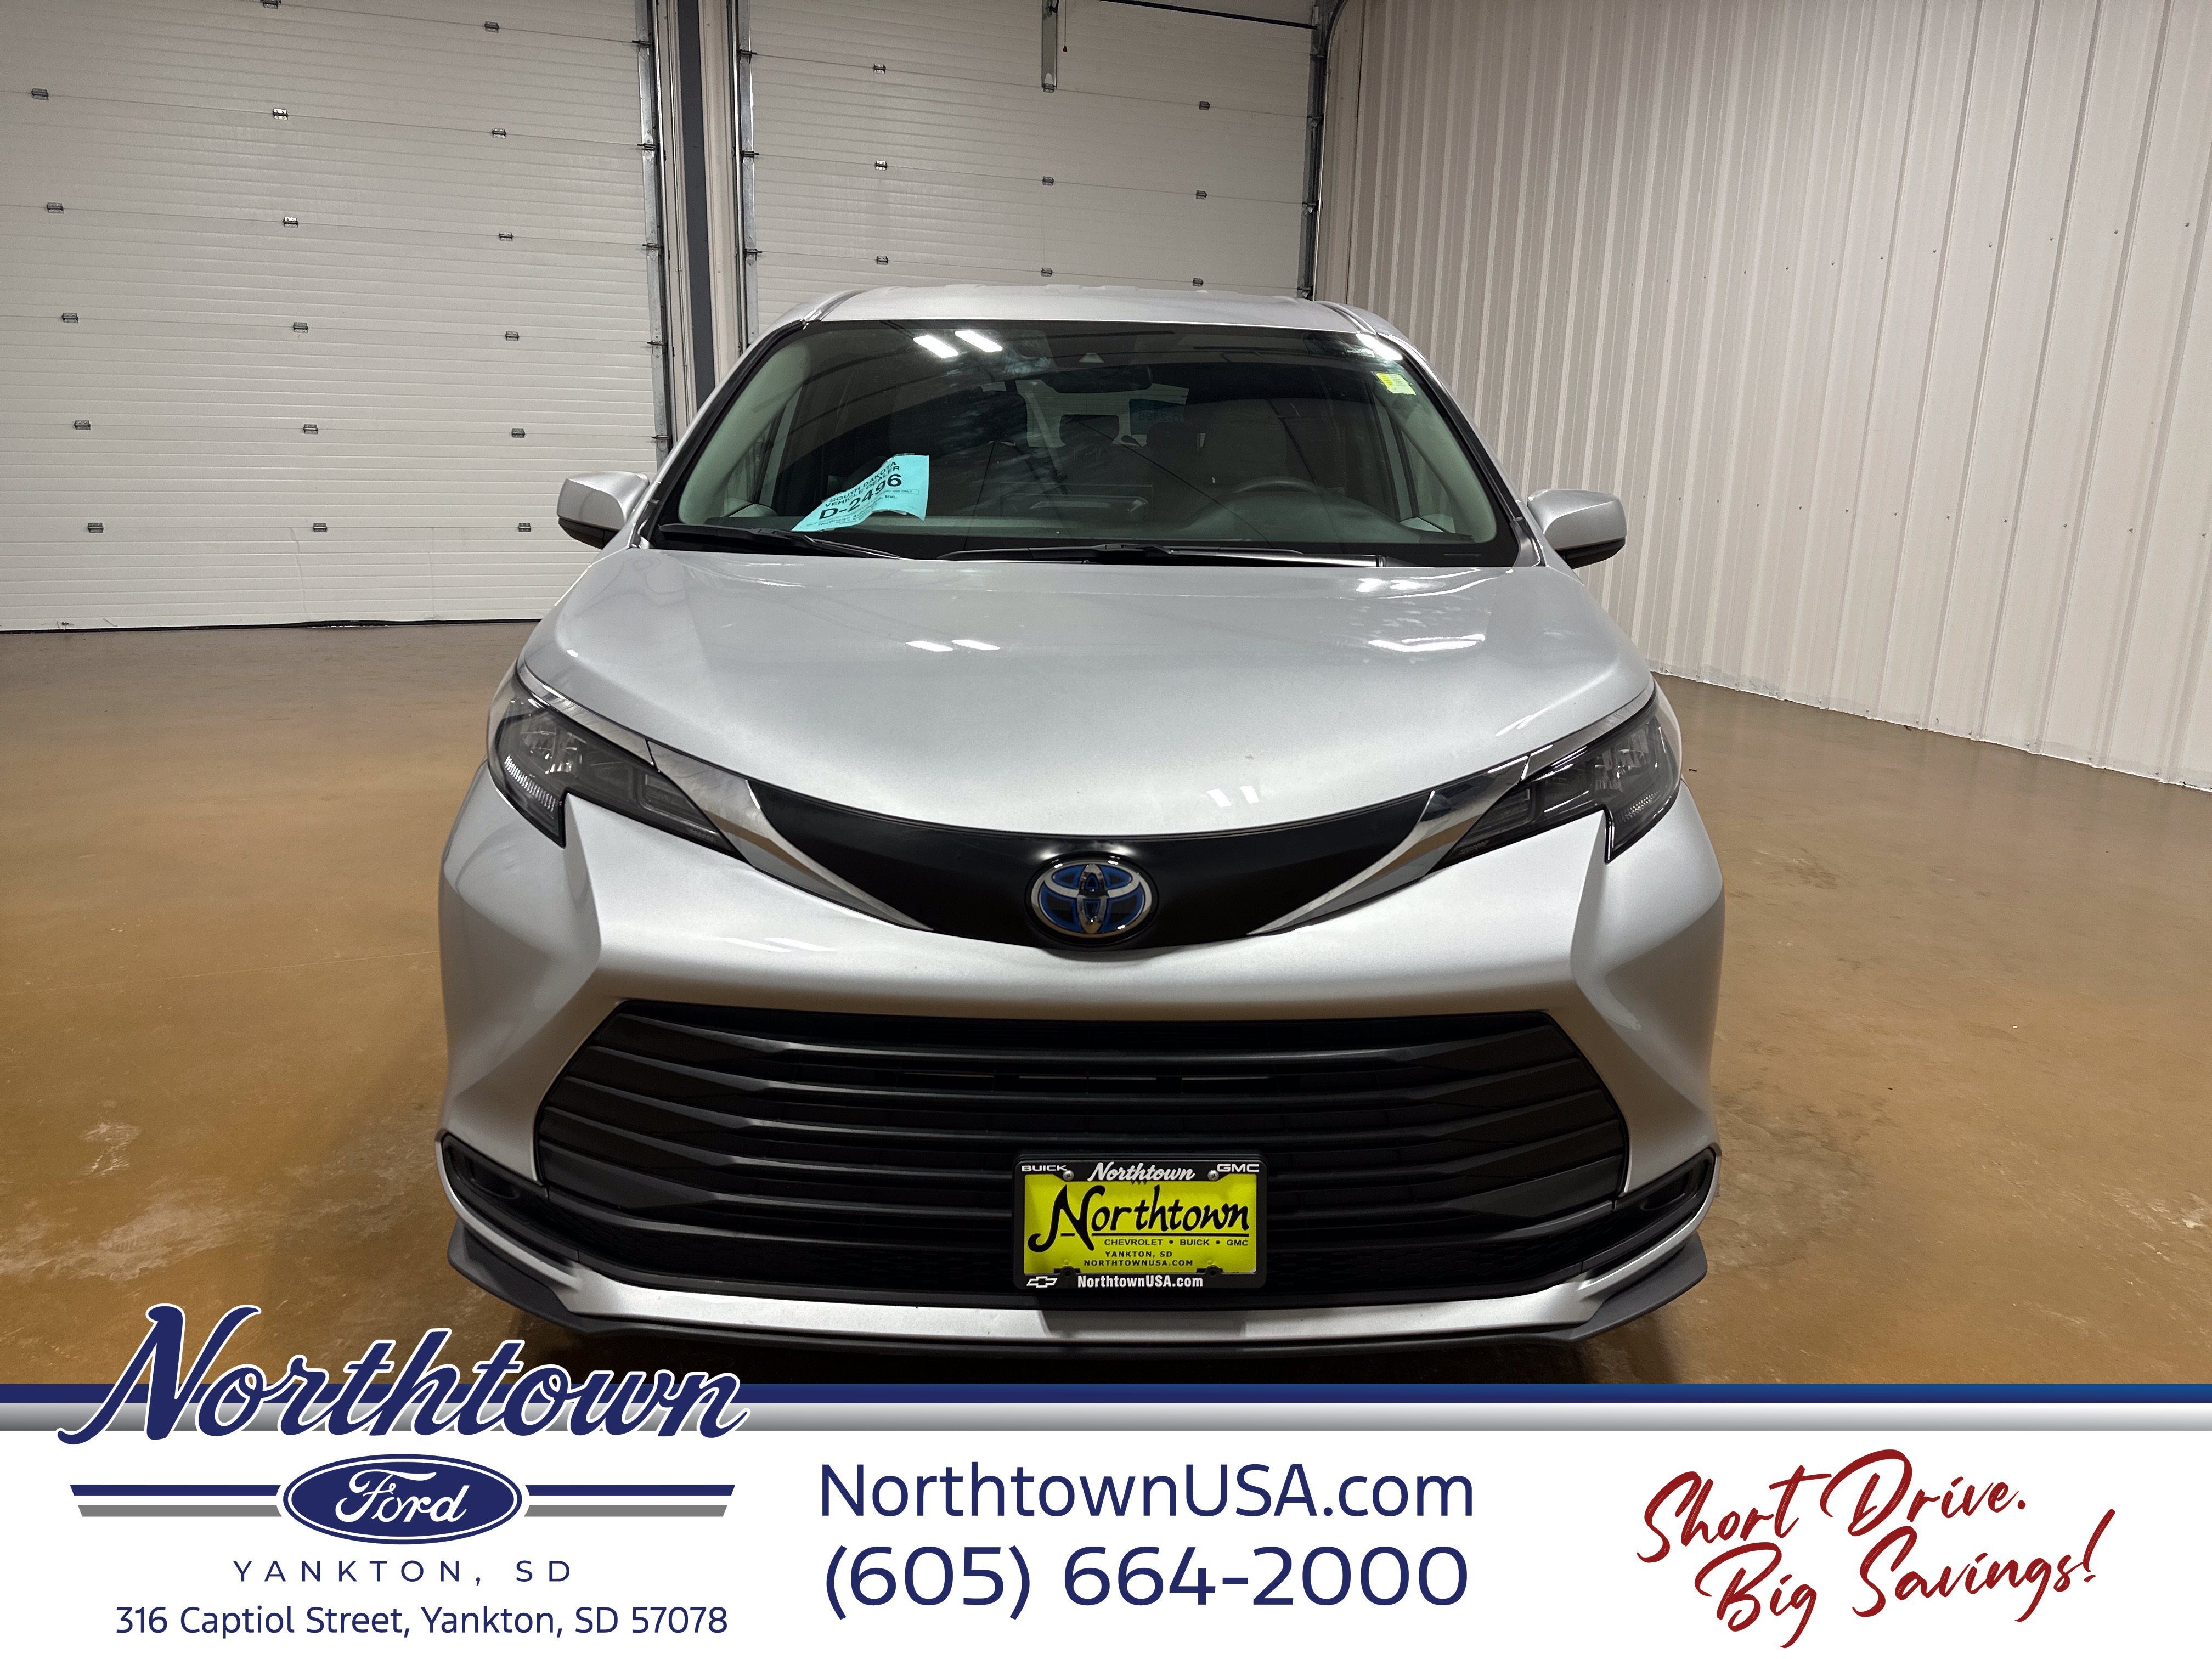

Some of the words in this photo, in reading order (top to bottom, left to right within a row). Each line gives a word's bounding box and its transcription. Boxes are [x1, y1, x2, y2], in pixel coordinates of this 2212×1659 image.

[819, 474, 902, 520] D-2496
[825, 490, 864, 507] VEHICLE
[866, 466, 900, 489] DEALER
[830, 487, 861, 502] SOUTH
[864, 461, 897, 487] DAKOTA
[1087, 1161, 1195, 1182] Northtown
[1217, 1164, 1260, 1173] GMC
[1028, 1184, 1250, 1253] Northtown
[1105, 1250, 1155, 1259] YANKTON,
[1077, 1274, 1204, 1289] NorthtownUSA.com
